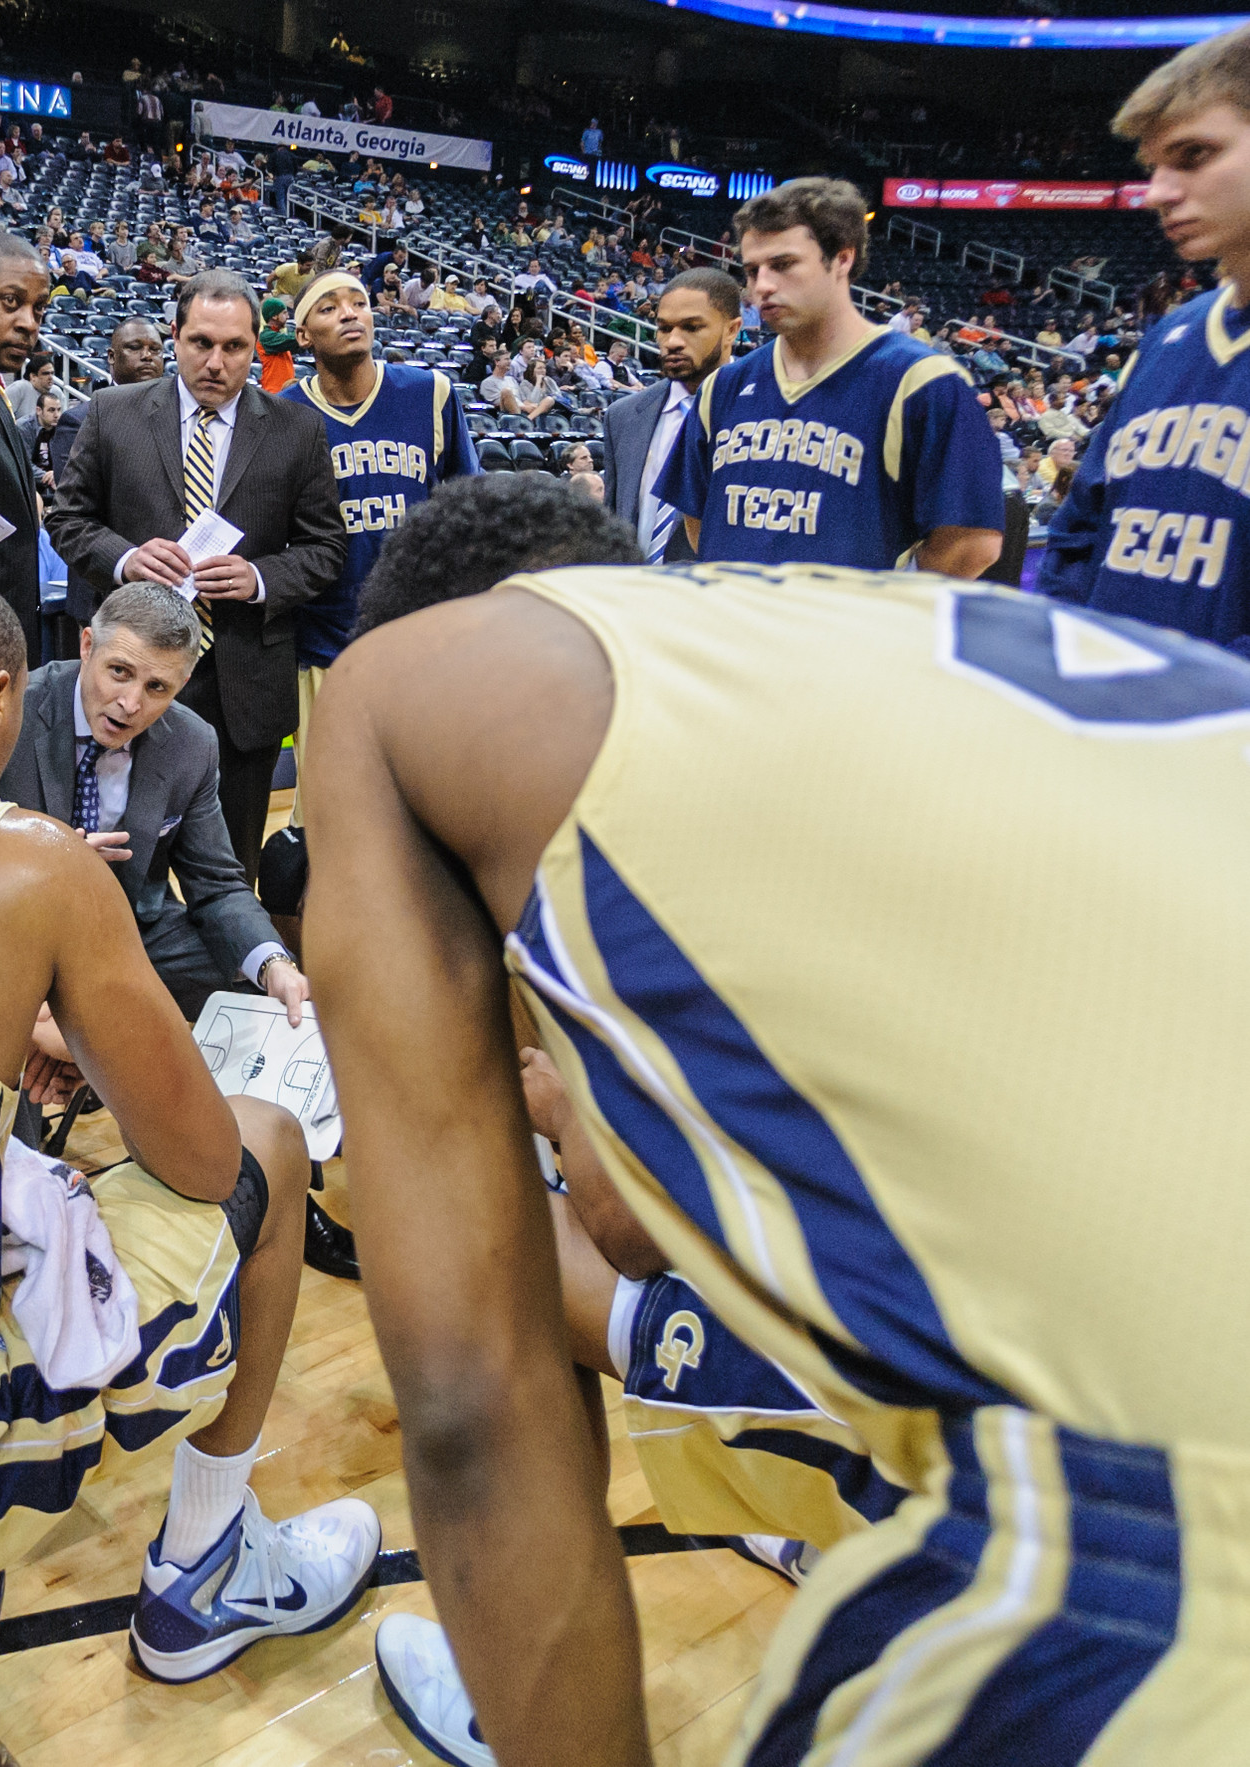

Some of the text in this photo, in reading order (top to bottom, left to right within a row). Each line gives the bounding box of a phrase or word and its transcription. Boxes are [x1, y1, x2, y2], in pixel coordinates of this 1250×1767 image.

[271, 118, 426, 159] Atlanta, Georgia
[658, 172, 717, 189] SCANA
[329, 438, 427, 484] ORGIA
[712, 417, 865, 486] GEORGIA
[339, 493, 406, 534] ECH
[724, 483, 823, 535] TECH
[1105, 506, 1233, 588] ECH
